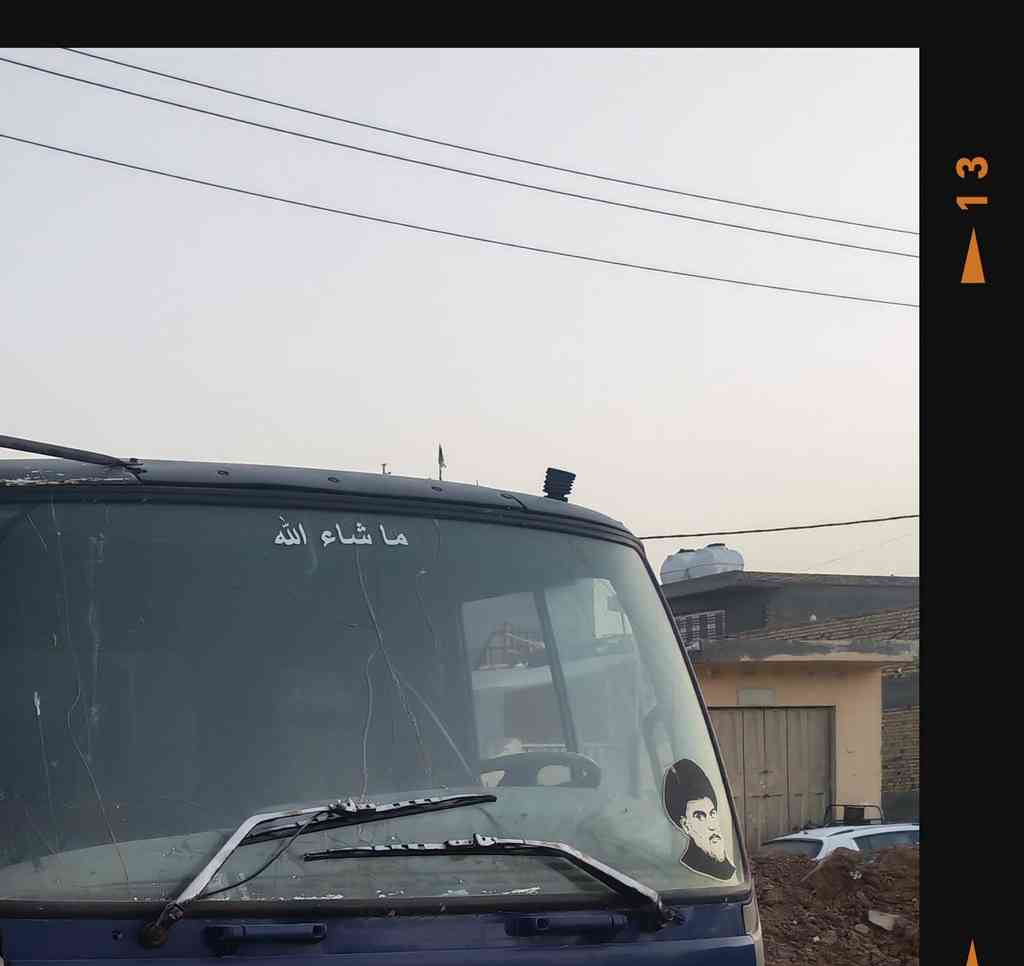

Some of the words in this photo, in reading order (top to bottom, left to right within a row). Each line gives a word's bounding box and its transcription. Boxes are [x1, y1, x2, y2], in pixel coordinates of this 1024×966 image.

[274, 515, 307, 545] الله
[320, 521, 373, 547] شاء
[378, 522, 409, 545] ما
